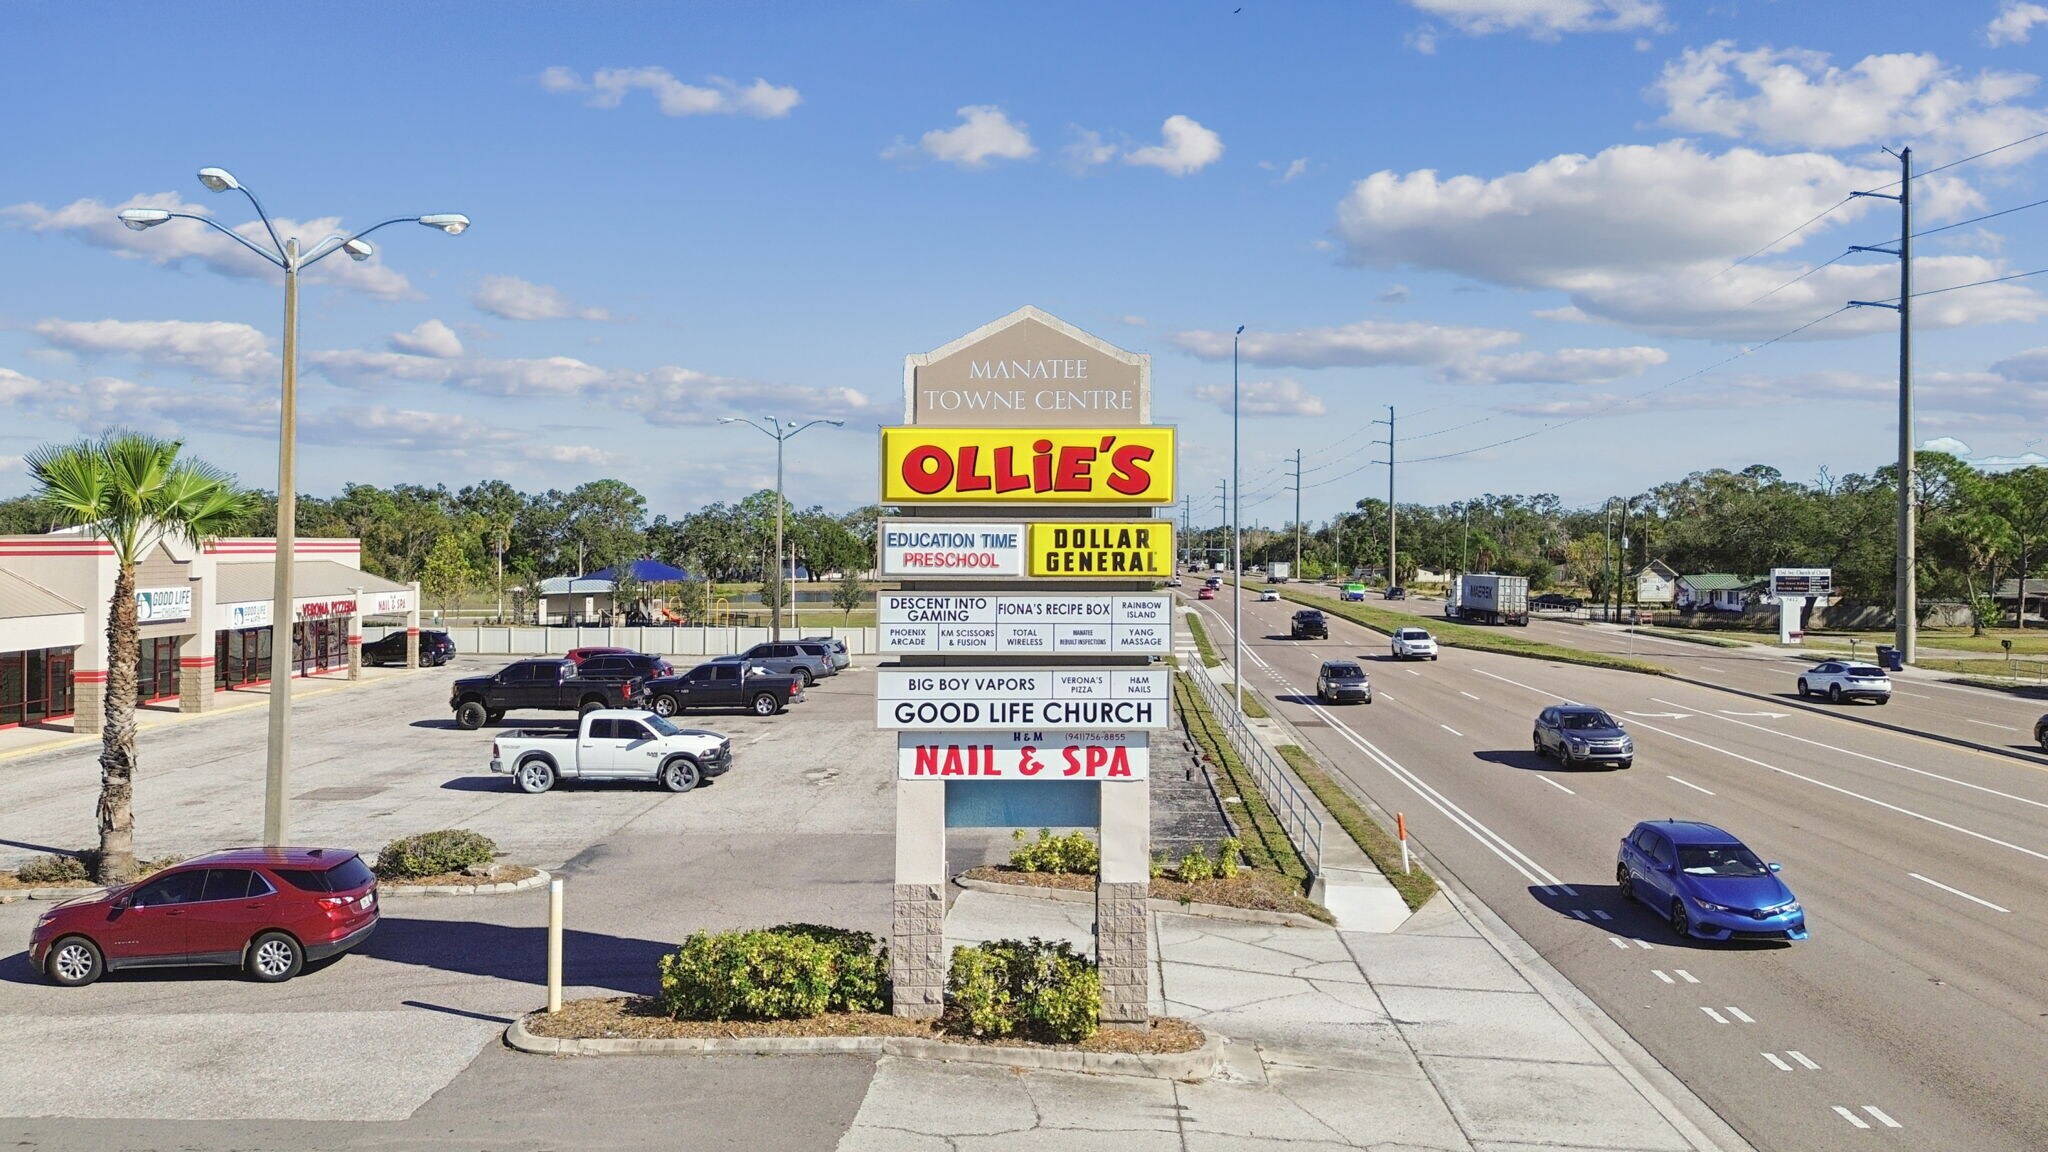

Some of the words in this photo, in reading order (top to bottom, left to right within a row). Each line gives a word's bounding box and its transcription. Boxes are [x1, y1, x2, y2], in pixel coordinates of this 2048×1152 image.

[969, 359, 1088, 379] MANATEE
[923, 390, 1026, 410] TOWNE
[1035, 390, 1133, 410] CENTRE
[887, 532, 975, 549] EDUCATION
[981, 532, 1018, 549] TIME
[1054, 528, 1150, 549] DOLLAR
[903, 552, 1000, 568] PRESCHOOL
[1046, 551, 1157, 572] GENERAL
[153, 591, 174, 606] GOOD
[175, 590, 190, 605] LIFE
[890, 598, 953, 610] DESCENT
[955, 598, 987, 610] INTO
[1121, 601, 1162, 609] RAINBOW
[998, 603, 1043, 615] FIONA'S
[1045, 603, 1084, 615] RECIPE
[1086, 603, 1110, 615] BOX
[907, 610, 970, 622] GAMING
[1126, 610, 1157, 619] ISLAND
[889, 628, 926, 636] PHOENIX
[941, 629, 954, 637] KM
[955, 629, 995, 637] SCISSORS
[1012, 629, 1037, 637] TOTAL
[1129, 628, 1154, 637] YANG
[891, 638, 926, 646] ARCADE
[949, 638, 955, 646] &
[957, 638, 987, 646] FUSION
[1006, 638, 1044, 646] WIRELESS
[1120, 638, 1162, 646] MASSAGE
[908, 678, 936, 691] BIG
[939, 678, 970, 691] BOY
[974, 678, 1035, 691] VAPORS
[1061, 676, 1103, 684] VERONA'S
[1130, 676, 1149, 684] H&M
[1071, 686, 1093, 694] PIZZA
[1128, 686, 1152, 694] NAILS
[895, 702, 980, 723] GOOD
[989, 702, 1034, 723] LIFE
[1043, 702, 1152, 723] CHURCH
[1013, 732, 1021, 741] H
[1023, 732, 1031, 741] &
[1033, 732, 1043, 741] M
[1065, 731, 1126, 741] (941)756-8855
[914, 744, 1001, 776] NAIL
[1018, 745, 1044, 776] &
[1062, 745, 1131, 777] SPA
